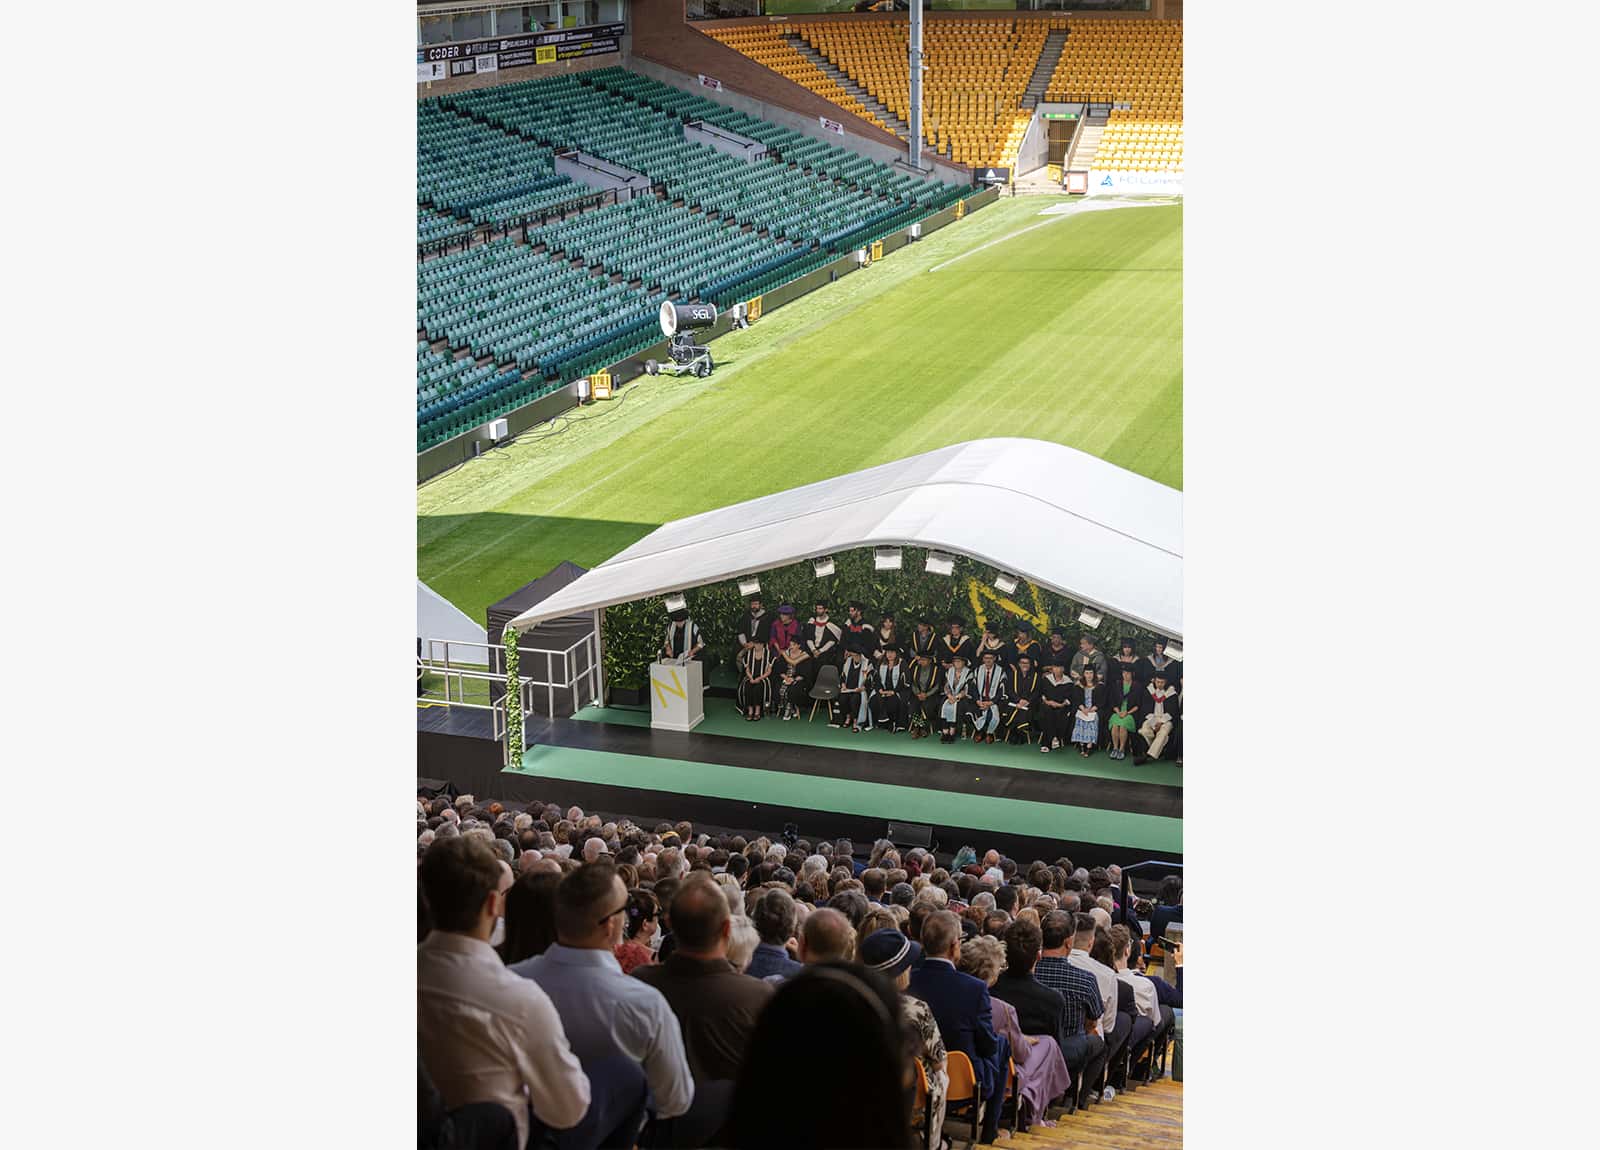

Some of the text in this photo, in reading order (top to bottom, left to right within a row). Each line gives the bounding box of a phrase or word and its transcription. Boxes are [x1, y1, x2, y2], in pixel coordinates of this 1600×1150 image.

[429, 46, 460, 60] CODER
[692, 309, 711, 320] SGL
[652, 666, 687, 709] N
